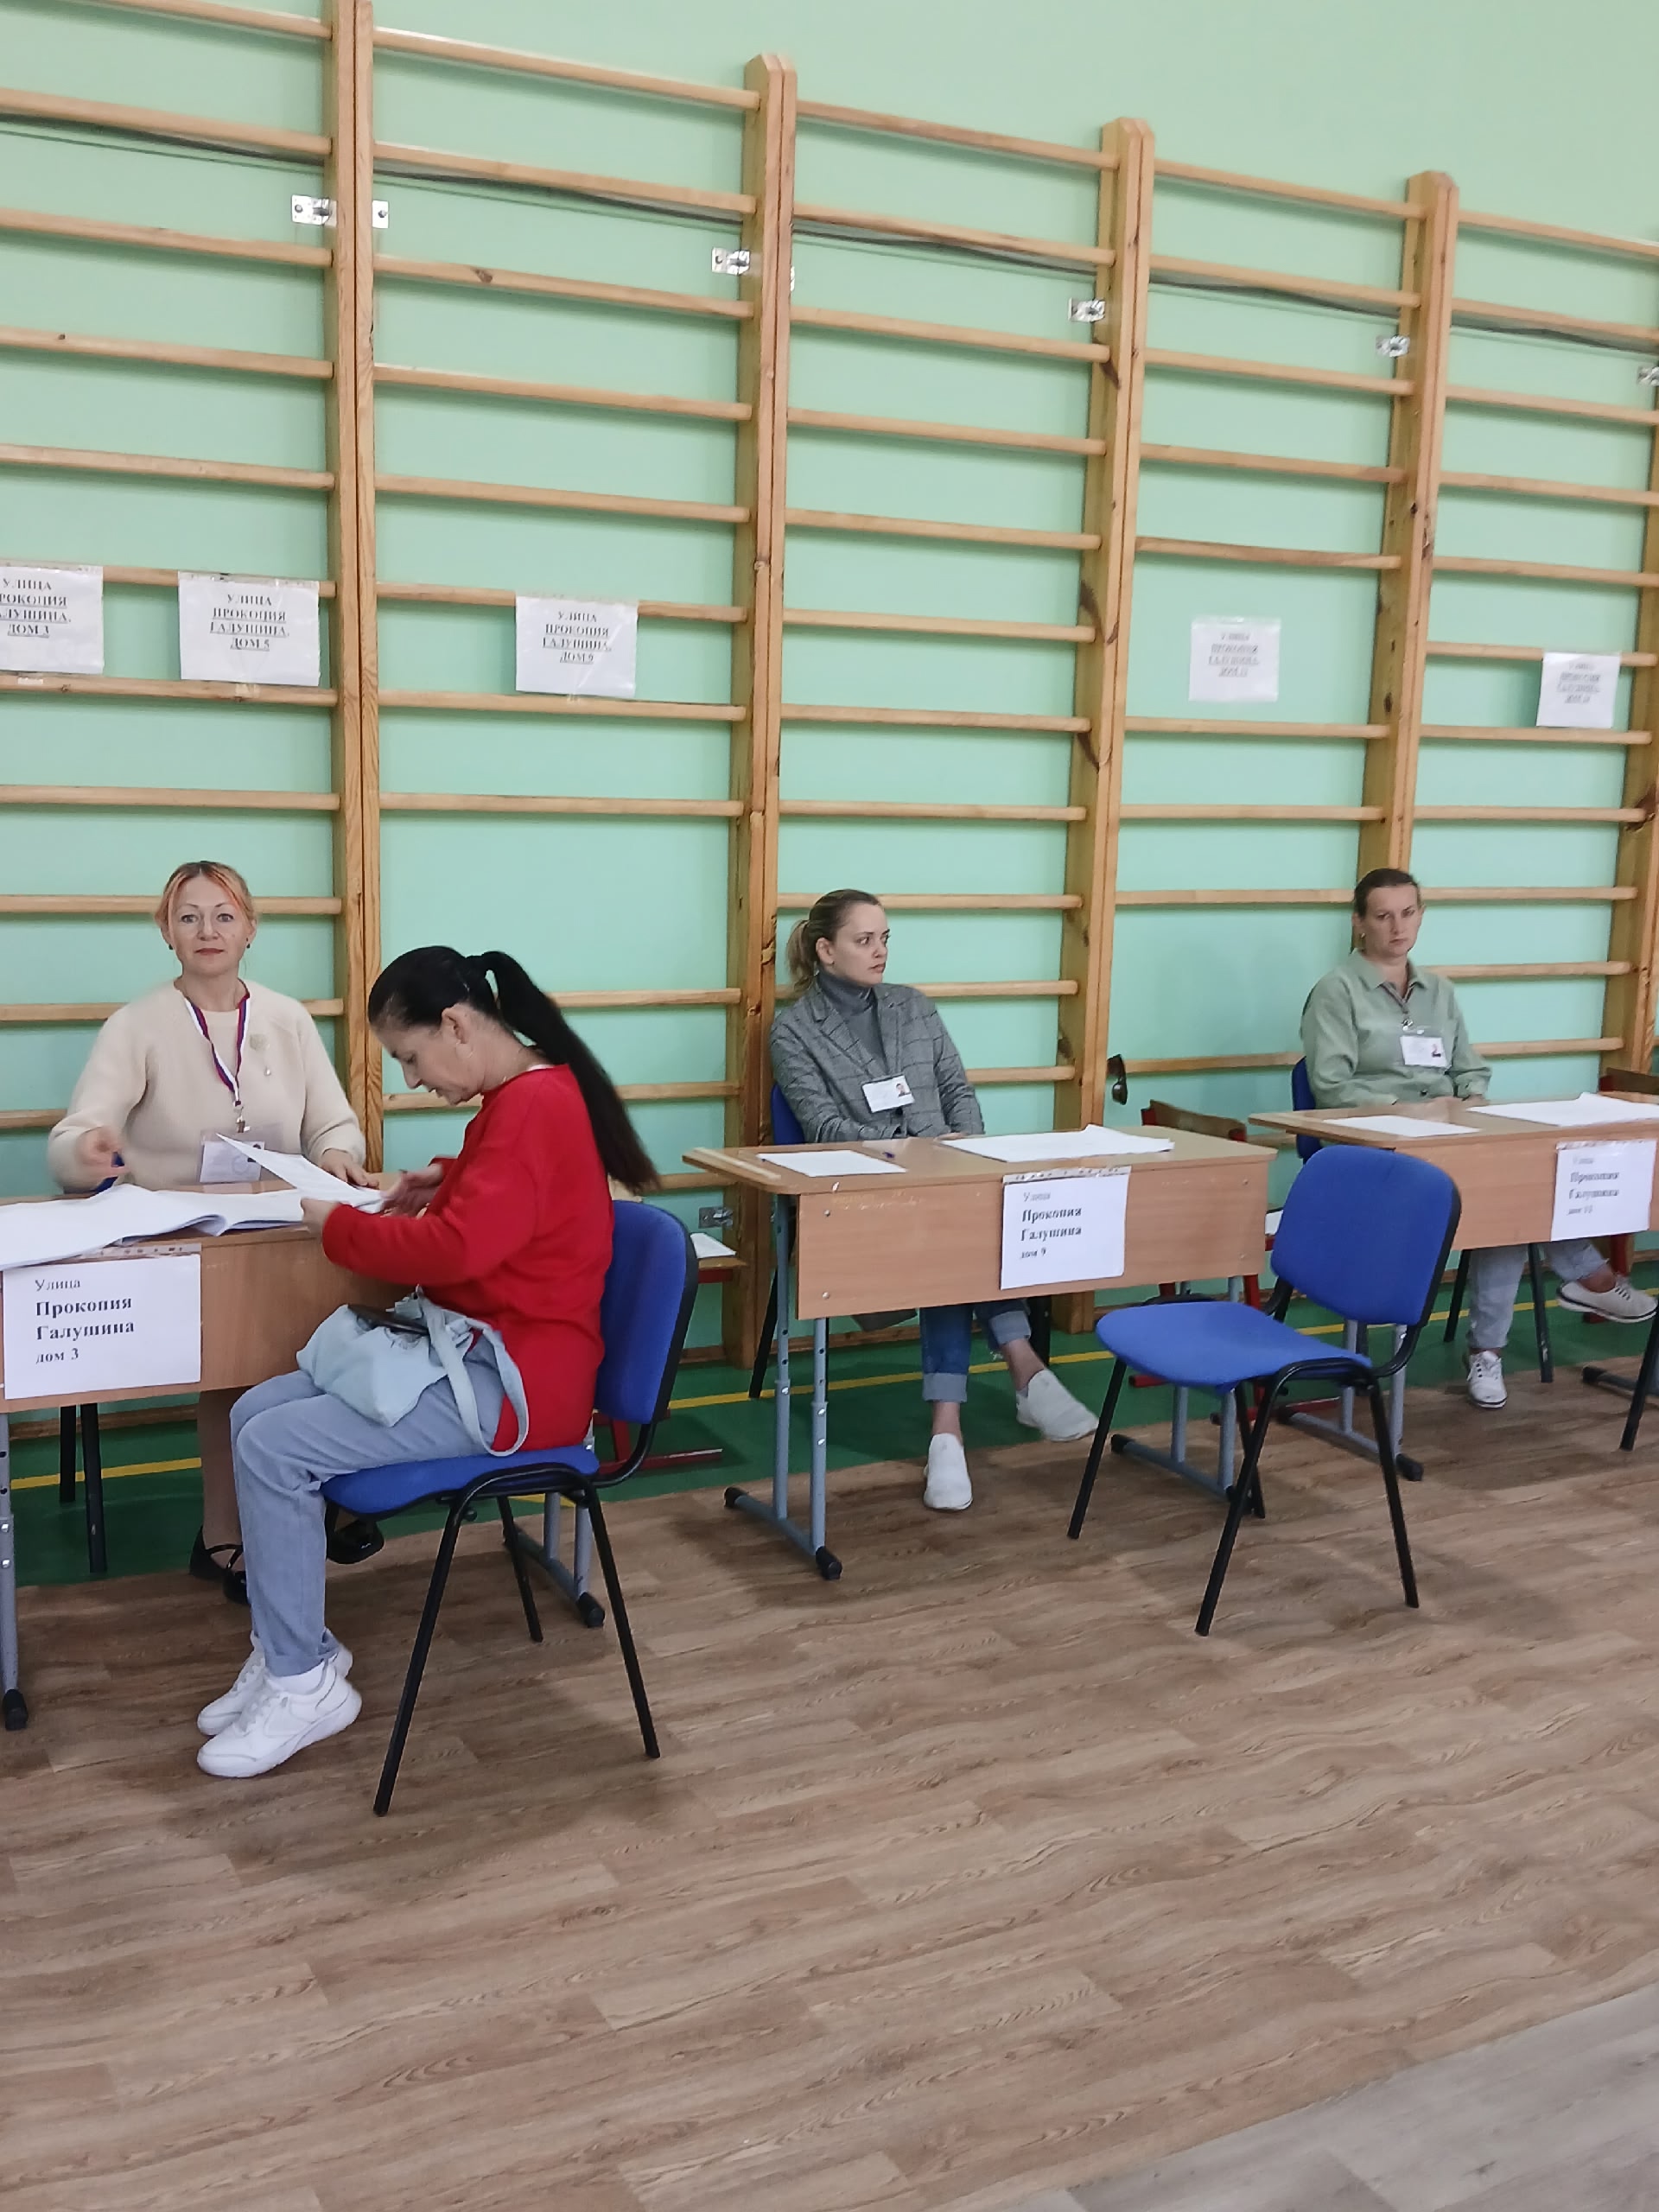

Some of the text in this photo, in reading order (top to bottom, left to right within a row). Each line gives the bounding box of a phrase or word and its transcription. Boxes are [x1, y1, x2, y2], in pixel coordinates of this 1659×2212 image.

[0, 593, 67, 607] РОКОПИЯ
[1021, 1207, 1083, 1224] Прокопия
[1020, 1226, 1083, 1242] Галушина
[35, 1279, 81, 1292] Улица
[35, 1298, 132, 1319] Прокопия
[36, 1321, 135, 1341] Галушина
[35, 1348, 79, 1363] дом 3
